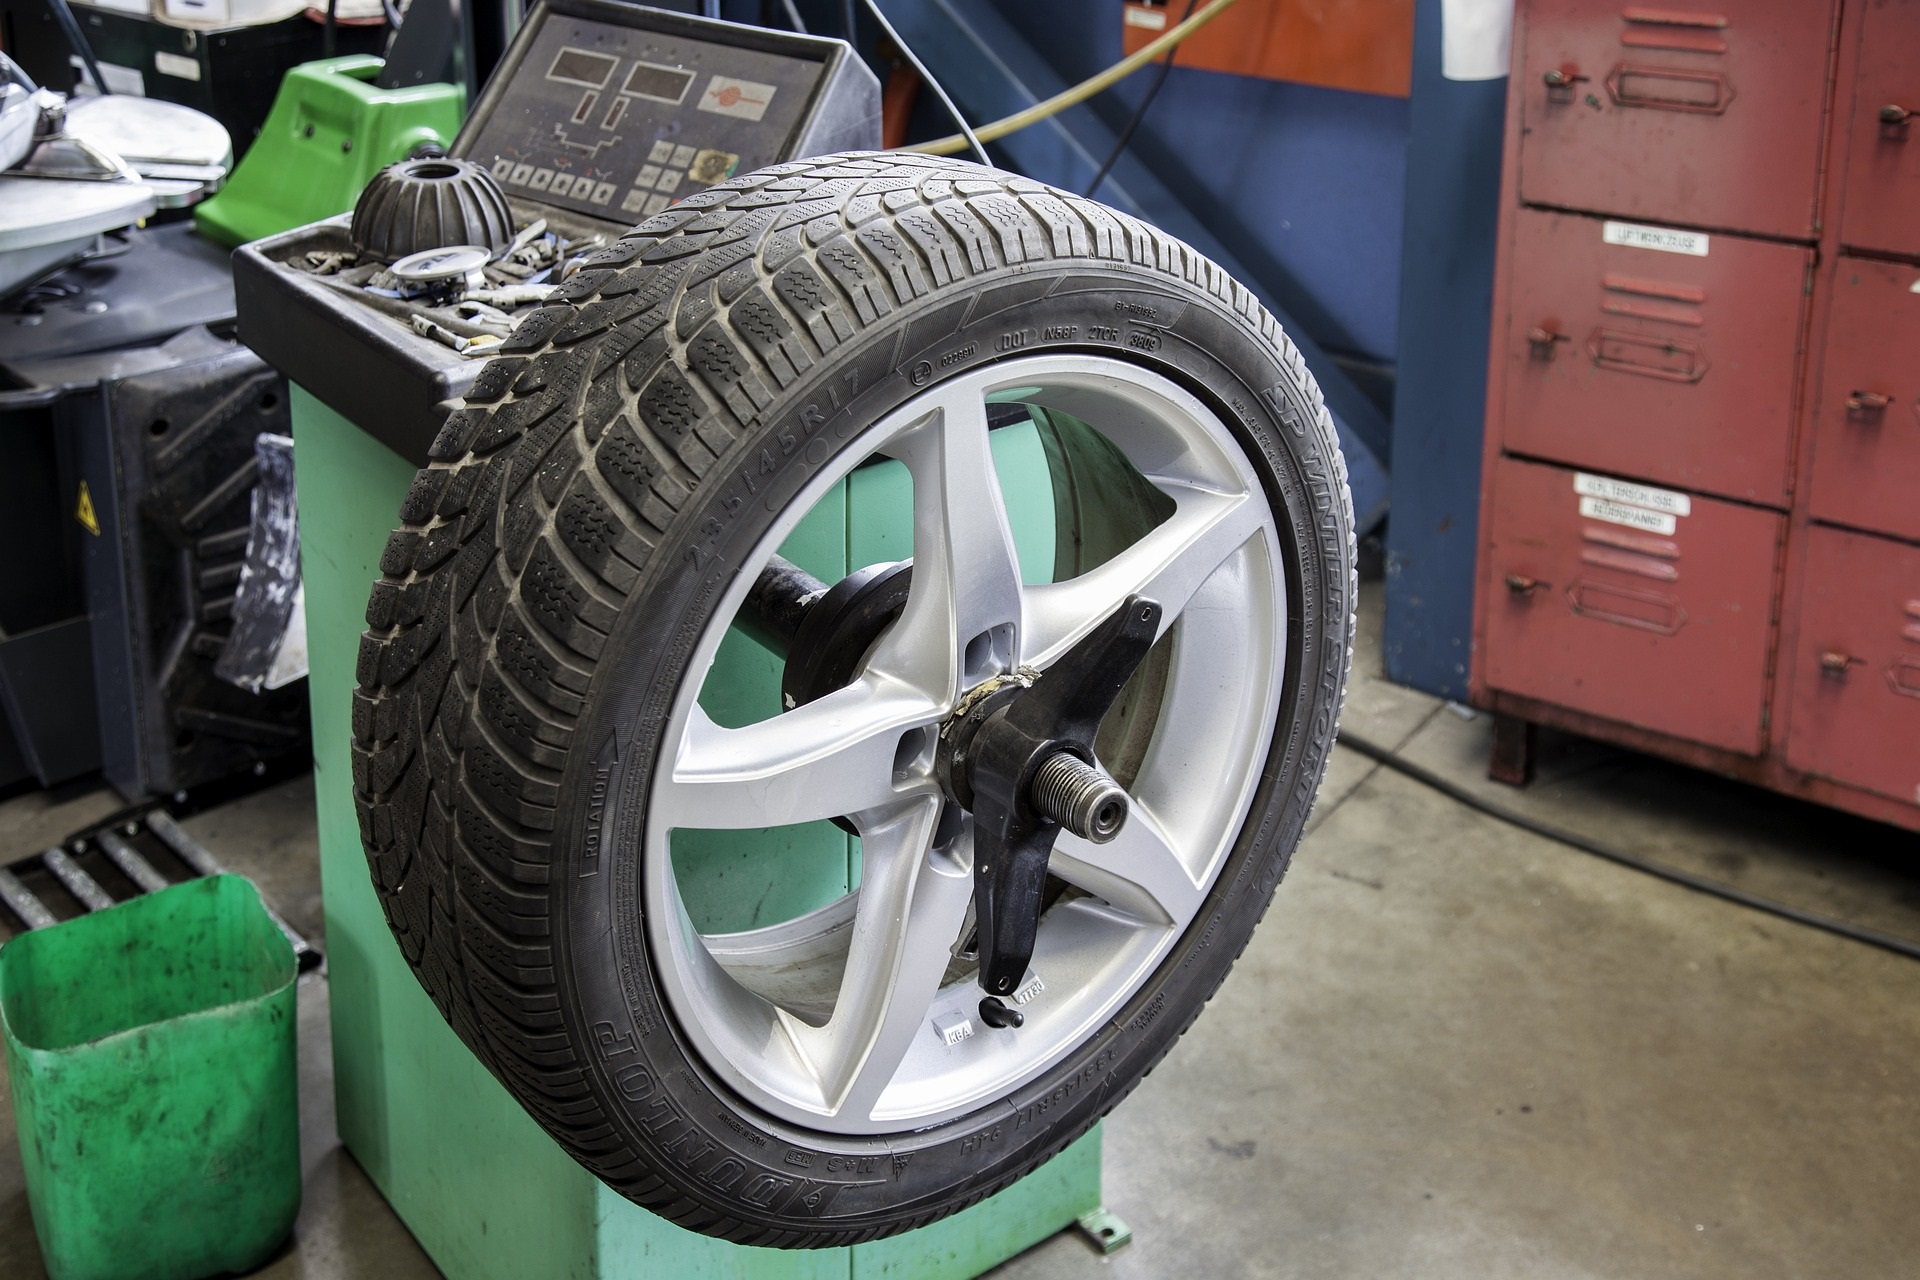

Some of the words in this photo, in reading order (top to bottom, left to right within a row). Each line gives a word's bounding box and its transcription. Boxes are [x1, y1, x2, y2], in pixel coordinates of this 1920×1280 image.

[1003, 329, 1029, 350] DOT
[1044, 325, 1078, 340] N58P
[1130, 332, 1157, 351] 3809
[1260, 381, 1306, 438] SP
[683, 367, 860, 572] 235/45R17
[1297, 442, 1343, 625] WINTER
[1294, 635, 1342, 819] SPORT
[585, 768, 609, 859] ROTATION
[1018, 981, 1044, 1005] 47730
[948, 1026, 971, 1044] KBA
[594, 1020, 794, 1208] DUNLOP
[960, 1126, 1001, 1156] 94H
[826, 1155, 879, 1173] M+S
